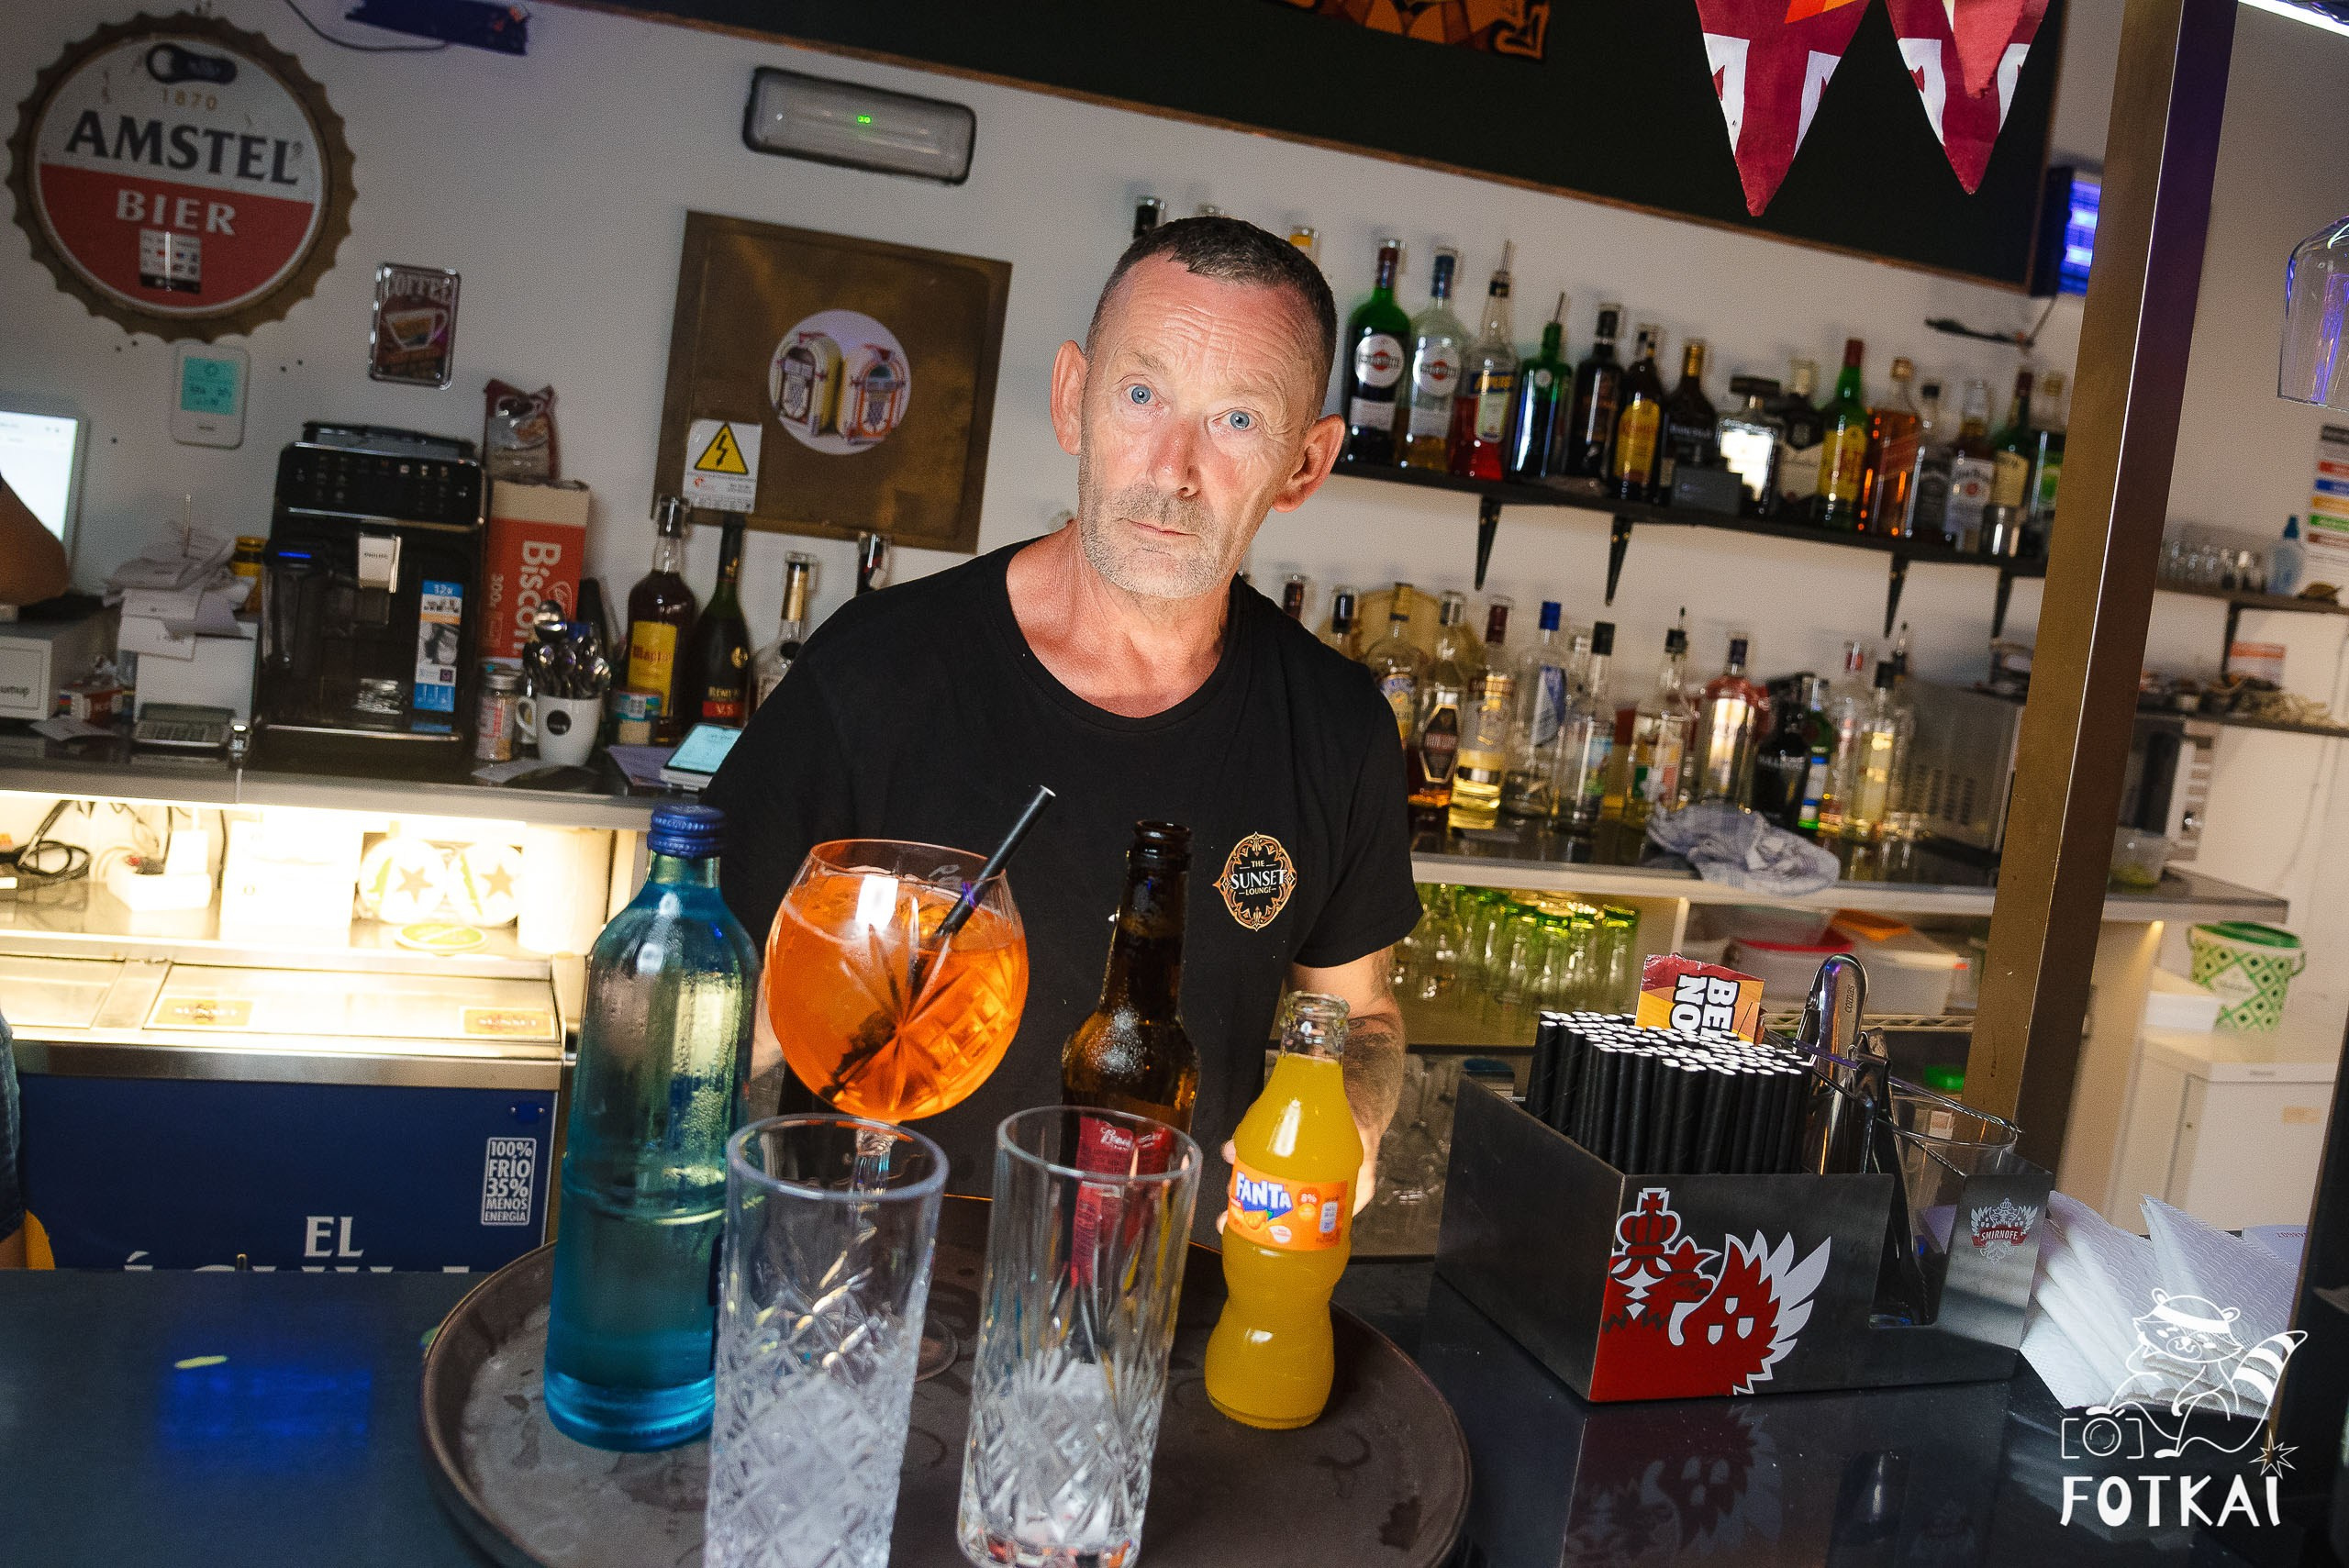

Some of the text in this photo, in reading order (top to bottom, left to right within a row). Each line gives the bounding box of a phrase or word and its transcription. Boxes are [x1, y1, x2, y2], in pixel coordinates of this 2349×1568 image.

[162, 89, 217, 110] 1870
[64, 109, 299, 185] AMSTEL
[116, 189, 236, 236] BIER
[1251, 860, 1265, 868] THE
[1230, 869, 1288, 890] SUNSET
[1844, 984, 1856, 1015] comas
[490, 1140, 532, 1157] 100%
[488, 1154, 531, 1178] FRÍO
[486, 1177, 529, 1198] 35%
[1236, 1171, 1293, 1209] FANTA
[485, 1197, 529, 1210] MENOS
[1300, 1193, 1318, 1204] 8%
[304, 1216, 364, 1258] EL
[1980, 1229, 2019, 1241] SMIRNOFF
